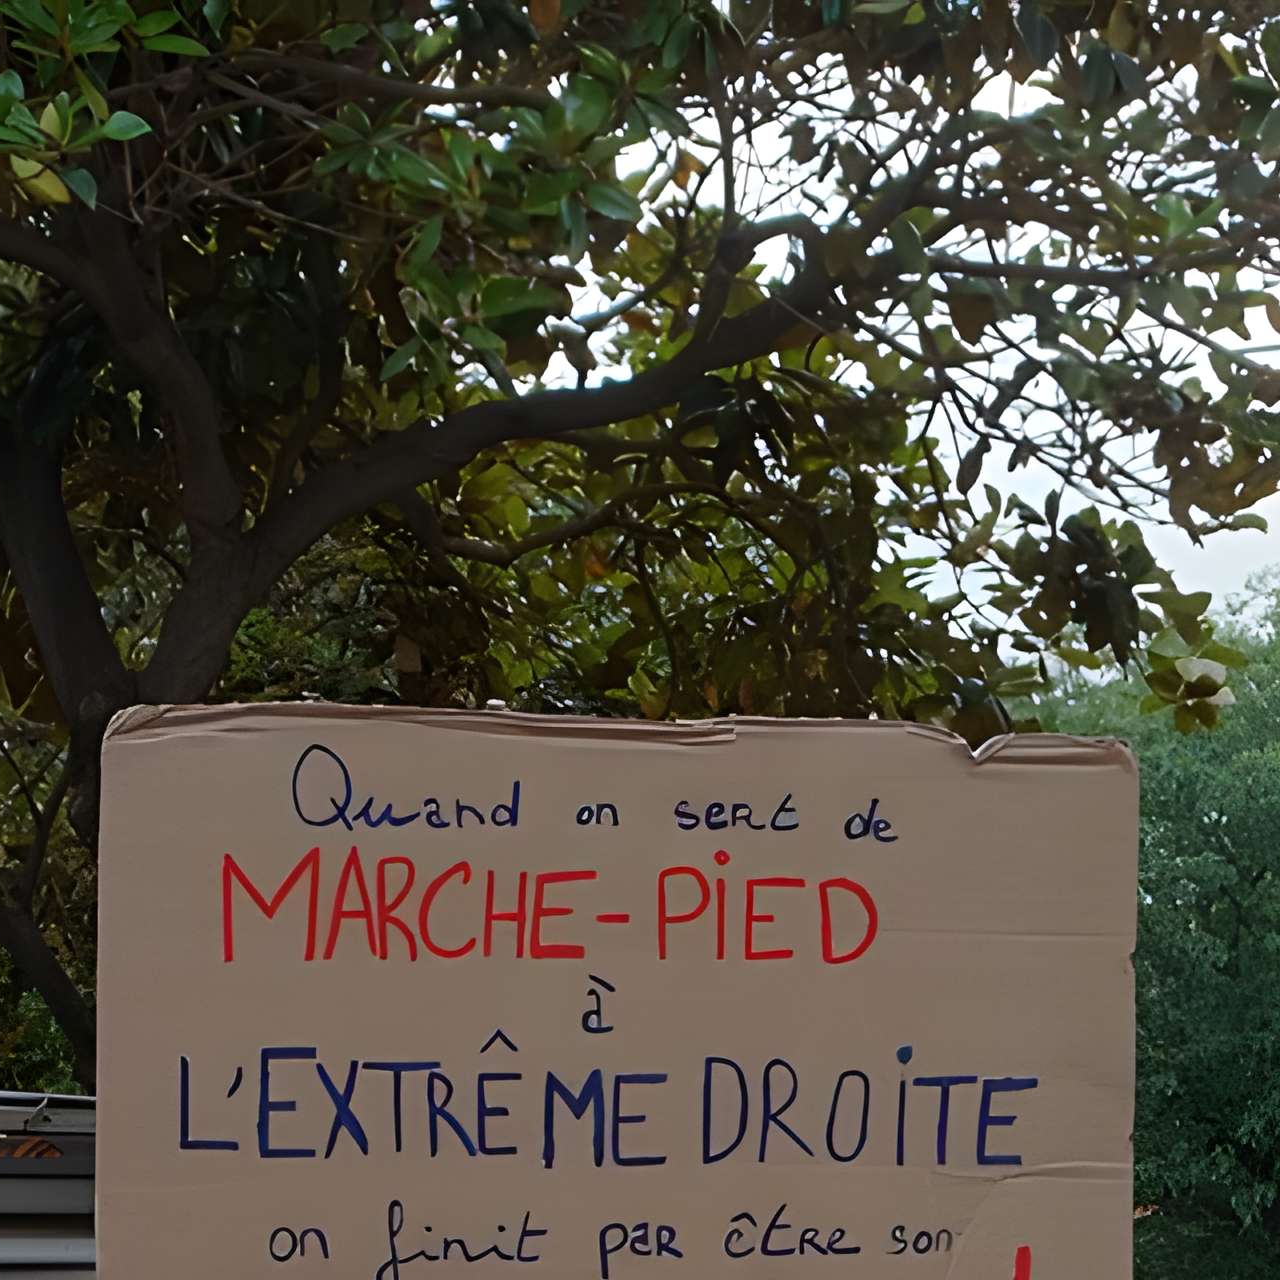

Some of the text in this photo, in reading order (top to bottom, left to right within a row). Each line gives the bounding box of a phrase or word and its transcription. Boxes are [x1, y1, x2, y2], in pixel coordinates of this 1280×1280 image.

[291, 743, 899, 843] Quand on sert de
[581, 974, 616, 1034] à
[268, 1226, 330, 1263] on
[598, 1221, 684, 1280] par
[723, 1203, 862, 1259] être
[886, 1224, 954, 1256] son
